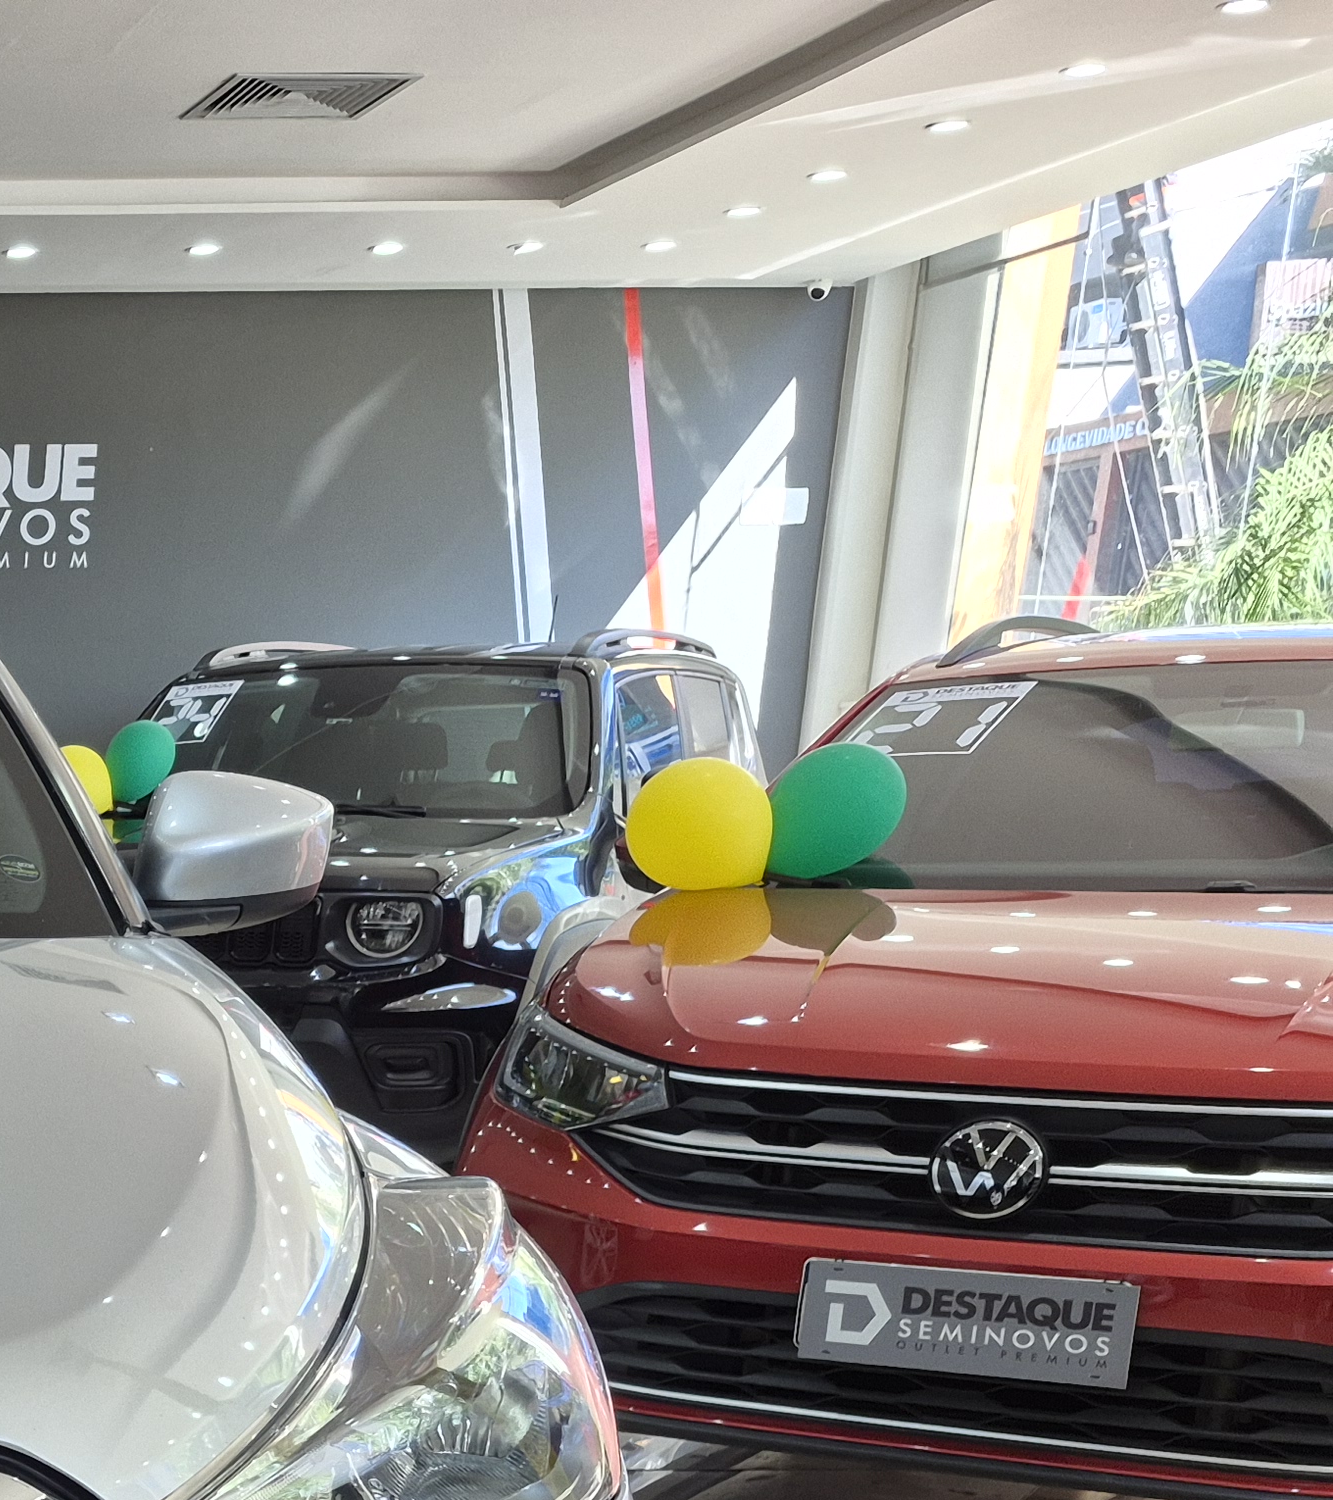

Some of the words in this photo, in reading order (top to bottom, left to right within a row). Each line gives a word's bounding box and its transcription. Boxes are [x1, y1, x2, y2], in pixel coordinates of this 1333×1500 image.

[1044, 420, 1135, 456] LONGEVIDADE
[935, 683, 1020, 694] DESTAQUE
[900, 1286, 1117, 1332] DESTAQUE
[896, 1340, 980, 1356] OUTLET
[1000, 1350, 1108, 1369] PREMIUM
[897, 1318, 1111, 1357] SEMINOVOS
